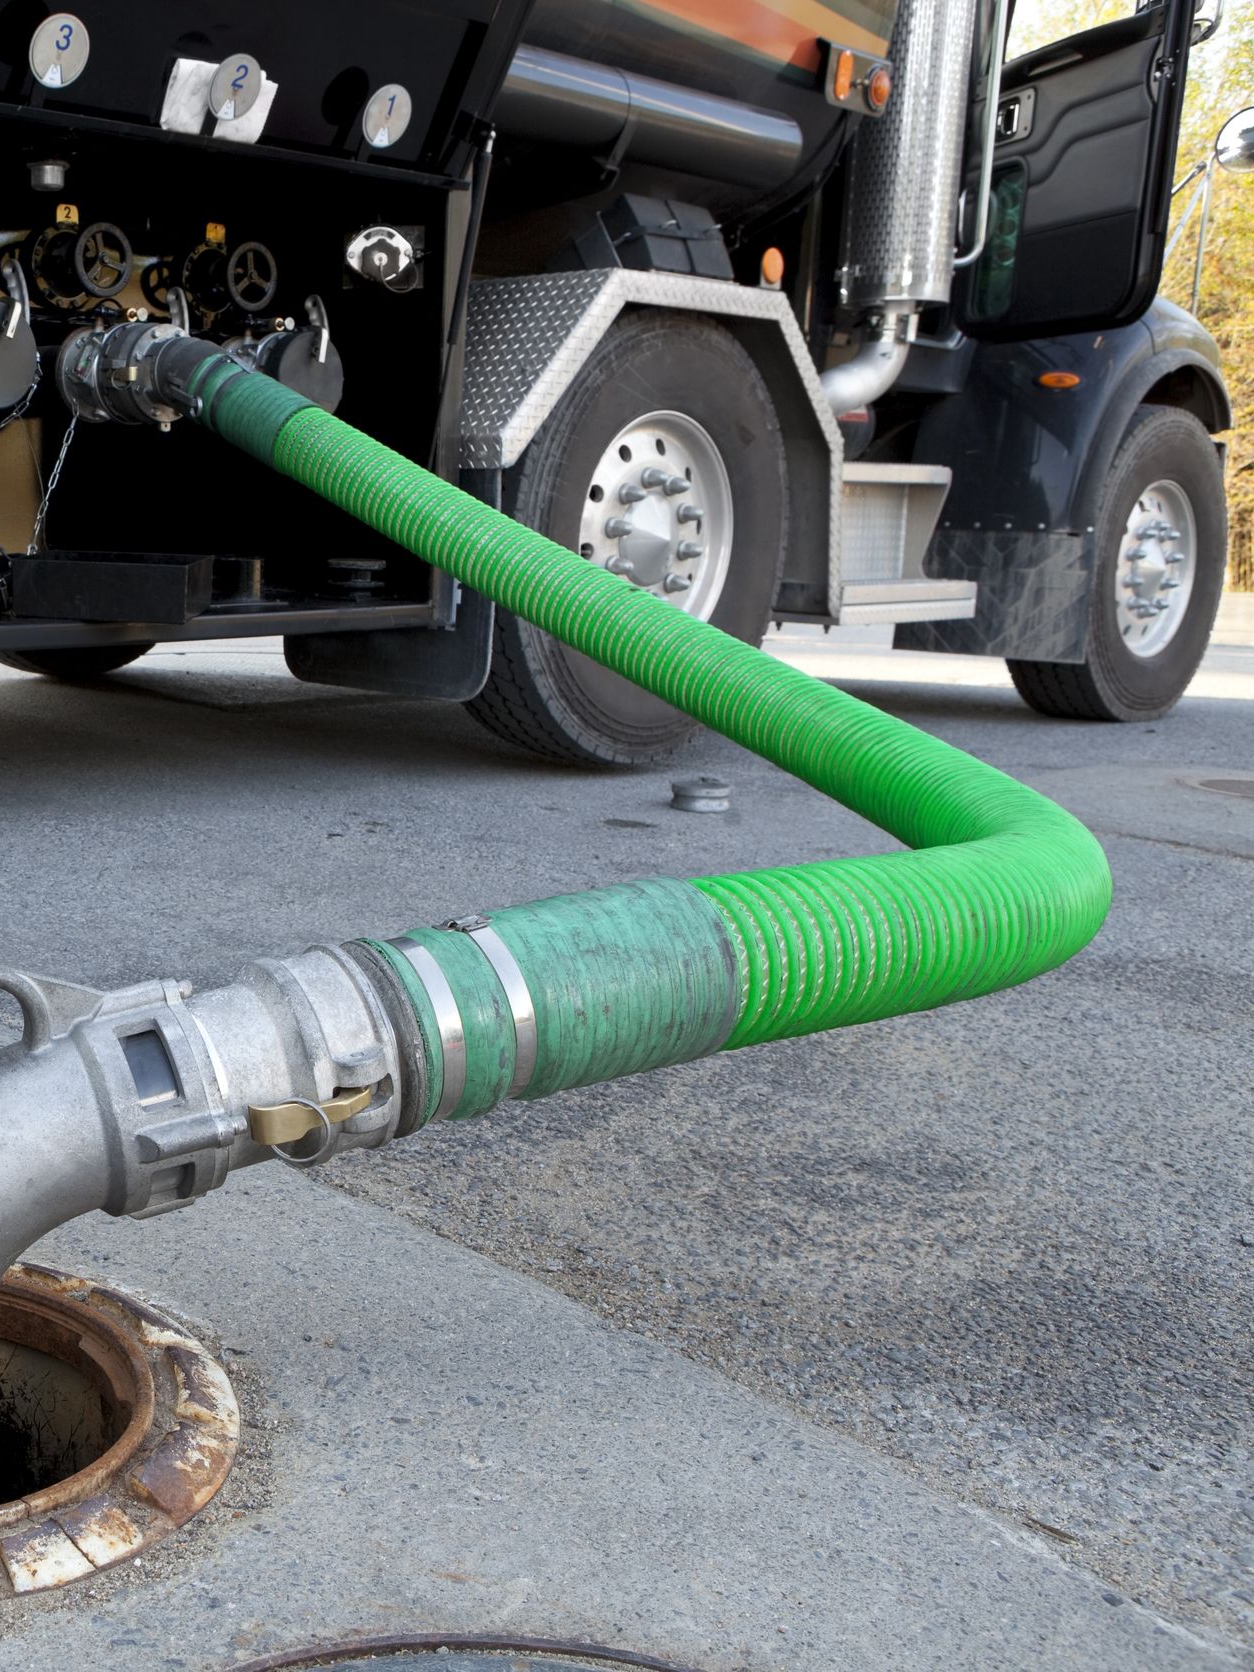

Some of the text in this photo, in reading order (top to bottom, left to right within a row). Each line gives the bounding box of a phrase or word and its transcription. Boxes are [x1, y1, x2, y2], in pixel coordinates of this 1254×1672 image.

[56, 24, 74, 51] 3
[231, 64, 249, 89] 2
[388, 94, 397, 116] 1
[63, 205, 72, 219] 2
